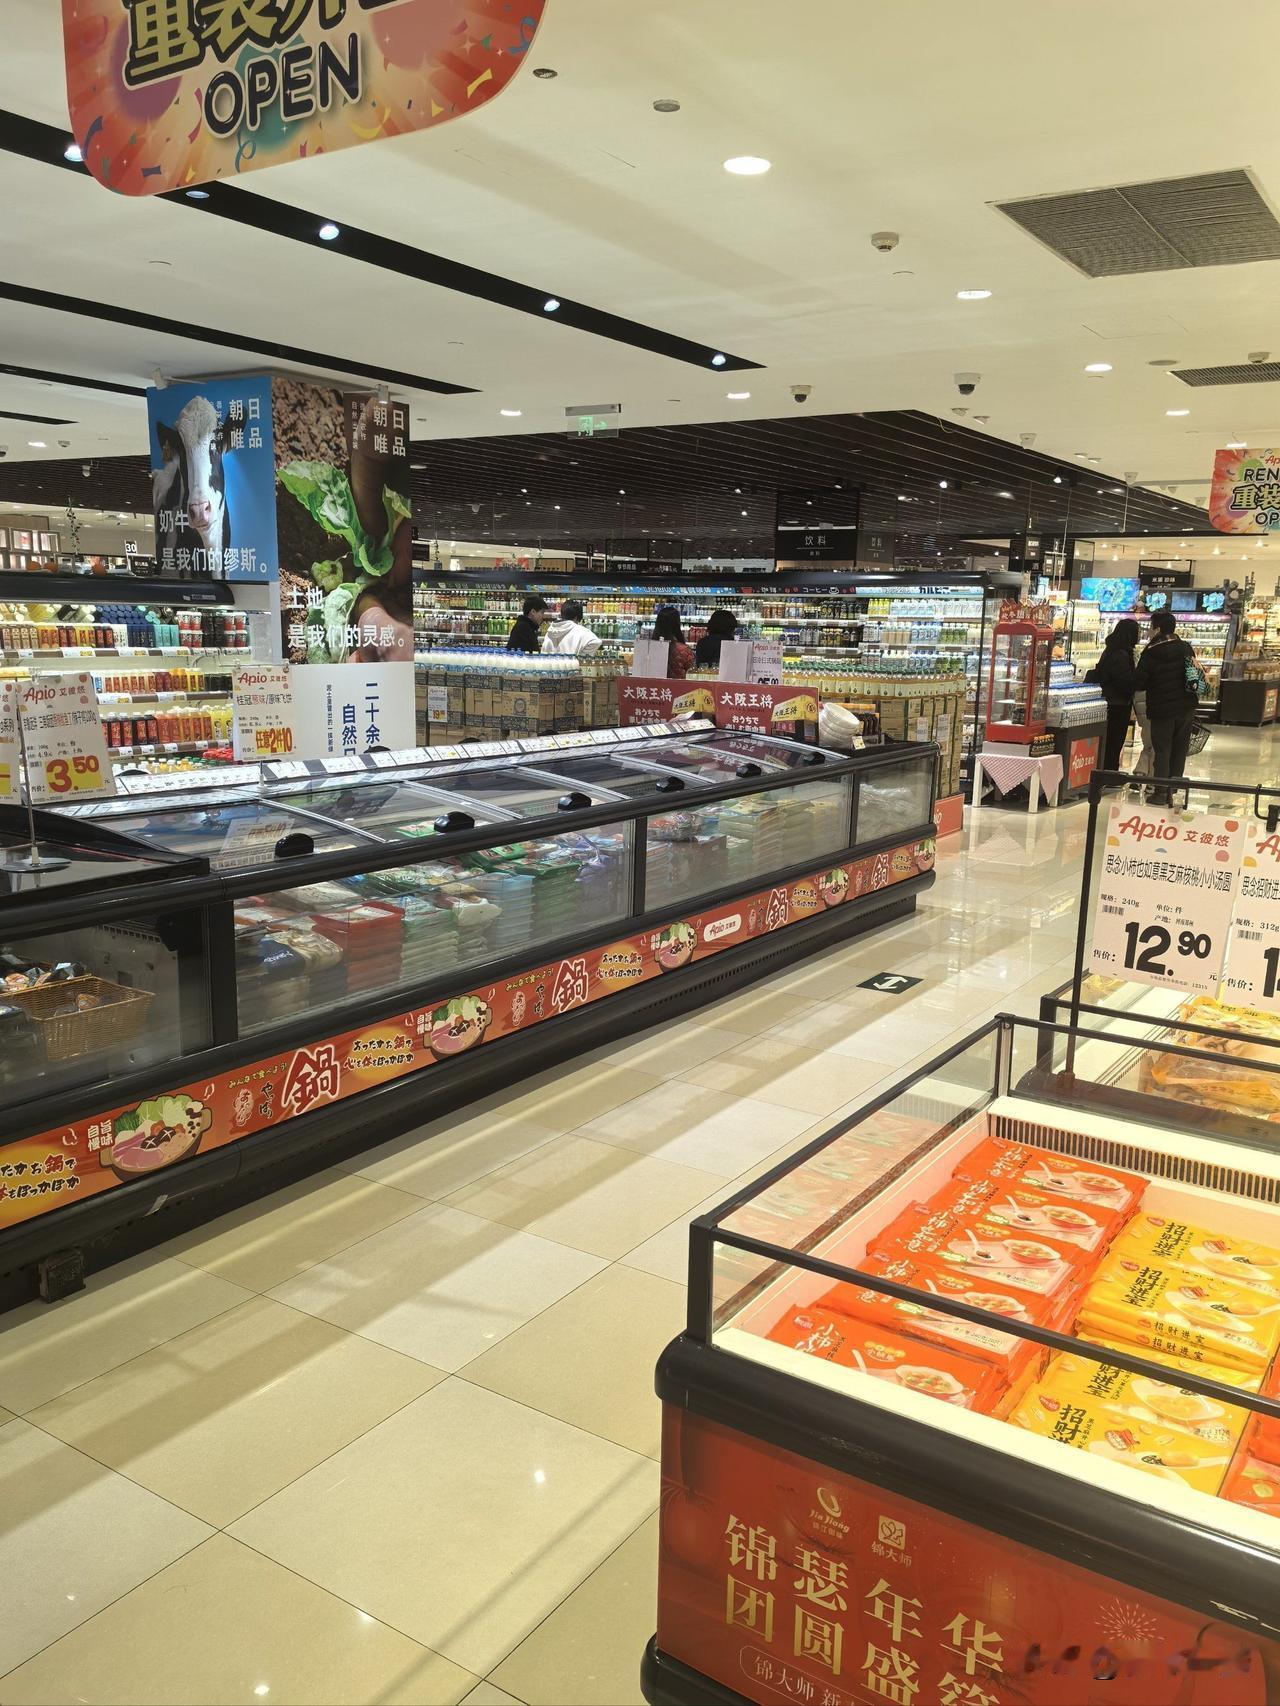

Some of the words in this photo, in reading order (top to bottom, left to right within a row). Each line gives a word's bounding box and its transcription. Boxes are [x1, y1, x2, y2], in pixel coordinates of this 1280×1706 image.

[204, 32, 361, 135] OPEN
[229, 398, 260, 420] 朝日
[373, 405, 405, 430] 朝日
[230, 427, 263, 449] 唯品
[374, 433, 407, 457] 唯品
[159, 510, 190, 533] 奶牛
[125, 543, 136, 553] 30
[804, 535, 827, 547] 饮料
[161, 547, 268, 573] 是我们的缪斯。
[286, 585, 325, 609] 土地
[287, 623, 405, 649] 是我们的灵感。
[238, 671, 268, 686] Apio
[23, 685, 56, 704] Apio
[623, 686, 673, 702] 大阪王将
[720, 692, 774, 709] 大阪王将
[46, 755, 100, 793] 3.50
[1119, 815, 1178, 842] Apio
[1184, 830, 1232, 847] 艾彼悠
[1242, 875, 1280, 902] 思念招财进
[765, 888, 789, 931] 鍋
[1122, 898, 1140, 908] 240g
[709, 922, 725, 937] Apio
[1124, 921, 1212, 976] 12.90
[552, 958, 588, 1014] 鍋
[281, 1043, 339, 1114] 鍋
[1121, 1267, 1163, 1308] 招财进宝
[824, 1515, 850, 1533] Jiang
[871, 1541, 912, 1568] 锦大师
[724, 1513, 1004, 1676] 锦瑟年华
[753, 1656, 814, 1701] 锦大师
